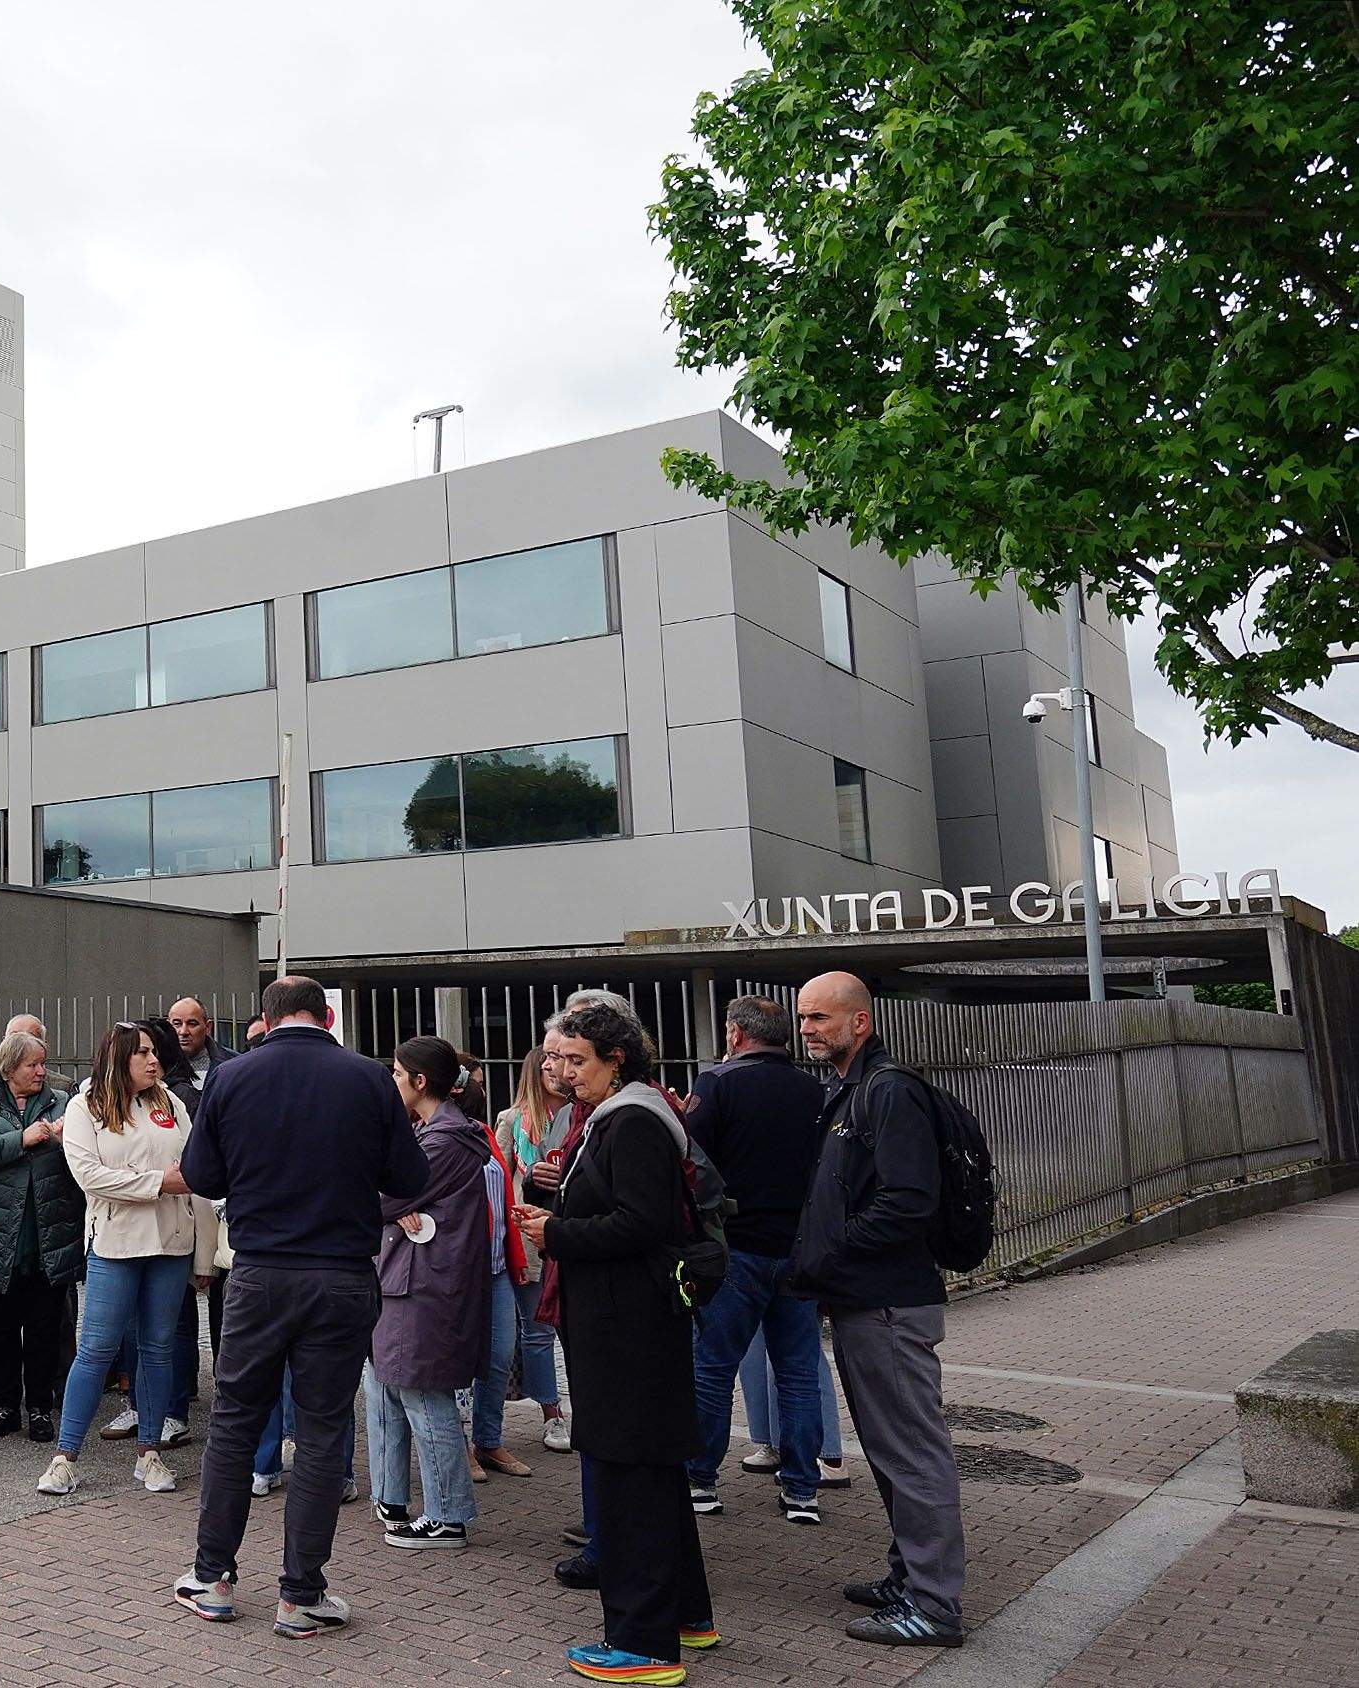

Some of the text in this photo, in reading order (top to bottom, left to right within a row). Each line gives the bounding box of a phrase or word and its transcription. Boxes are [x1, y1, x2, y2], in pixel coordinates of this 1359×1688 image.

[721, 868, 1284, 938] XUNTA DE GALICIA
